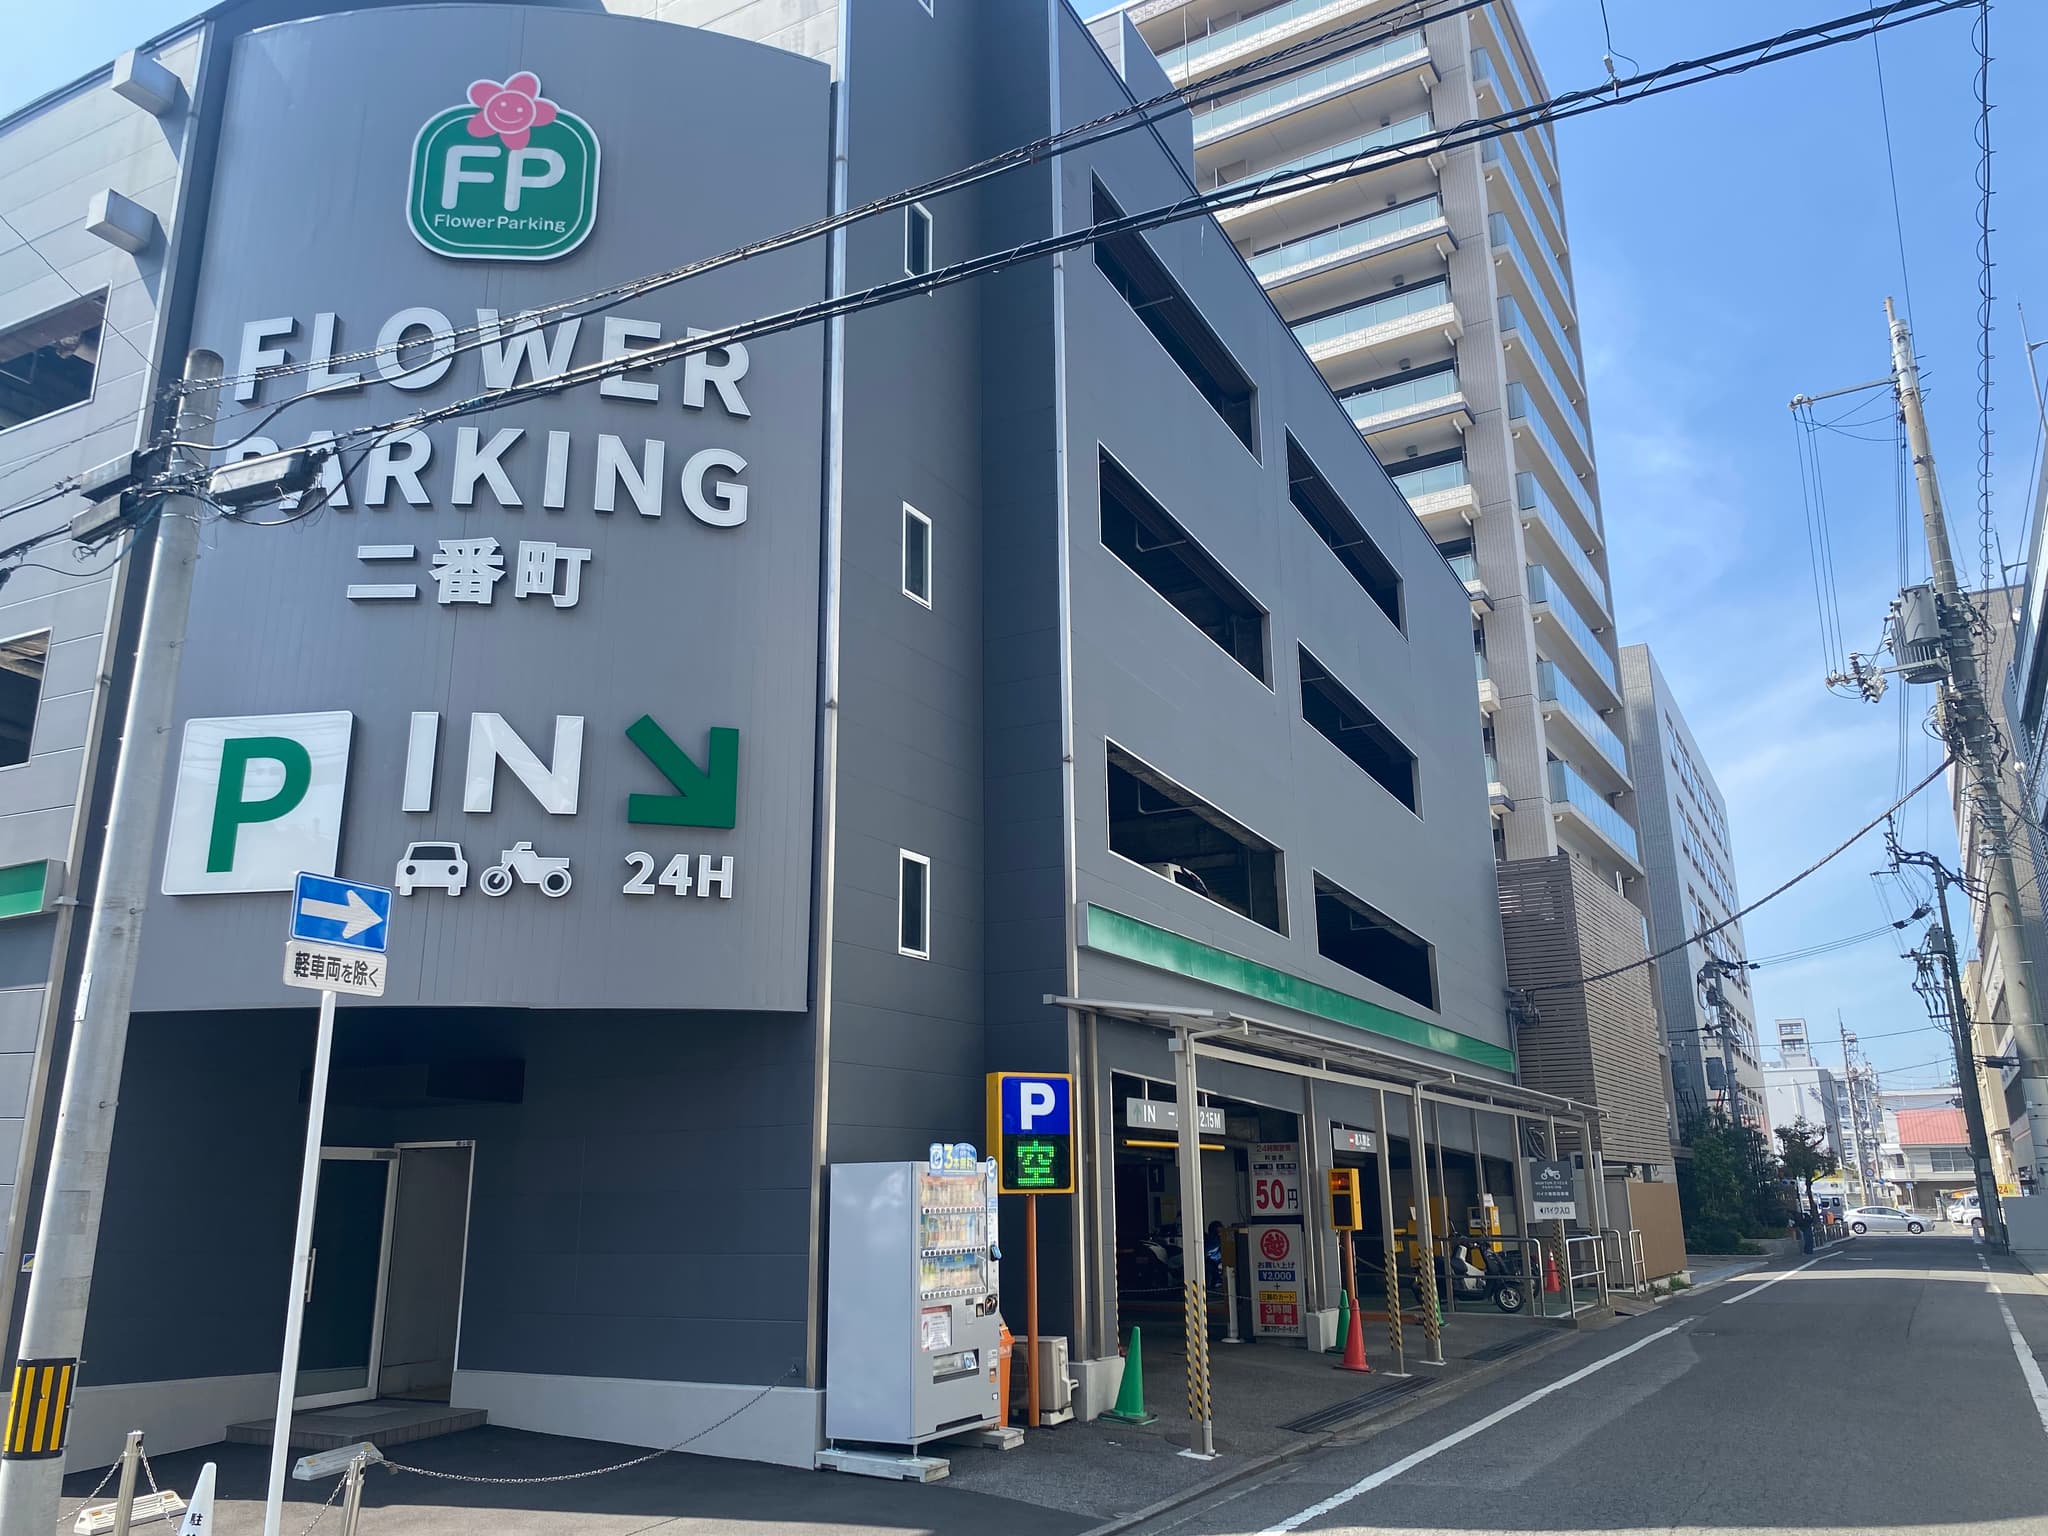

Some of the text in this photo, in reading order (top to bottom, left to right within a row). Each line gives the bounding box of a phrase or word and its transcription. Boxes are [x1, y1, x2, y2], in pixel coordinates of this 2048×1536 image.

[441, 145, 566, 212] FP
[434, 213, 567, 233] Flower Parking
[235, 307, 753, 419] FLOWER
[346, 536, 592, 609] 二番町
[205, 711, 585, 874] P IN
[622, 849, 735, 900] 24H
[294, 951, 378, 987] 軽車両を除く
[1020, 1082, 1056, 1130] P
[1143, 1105, 1156, 1123] IN
[1016, 1139, 1056, 1187] 空
[1262, 1271, 1292, 1281] ¥2,000
